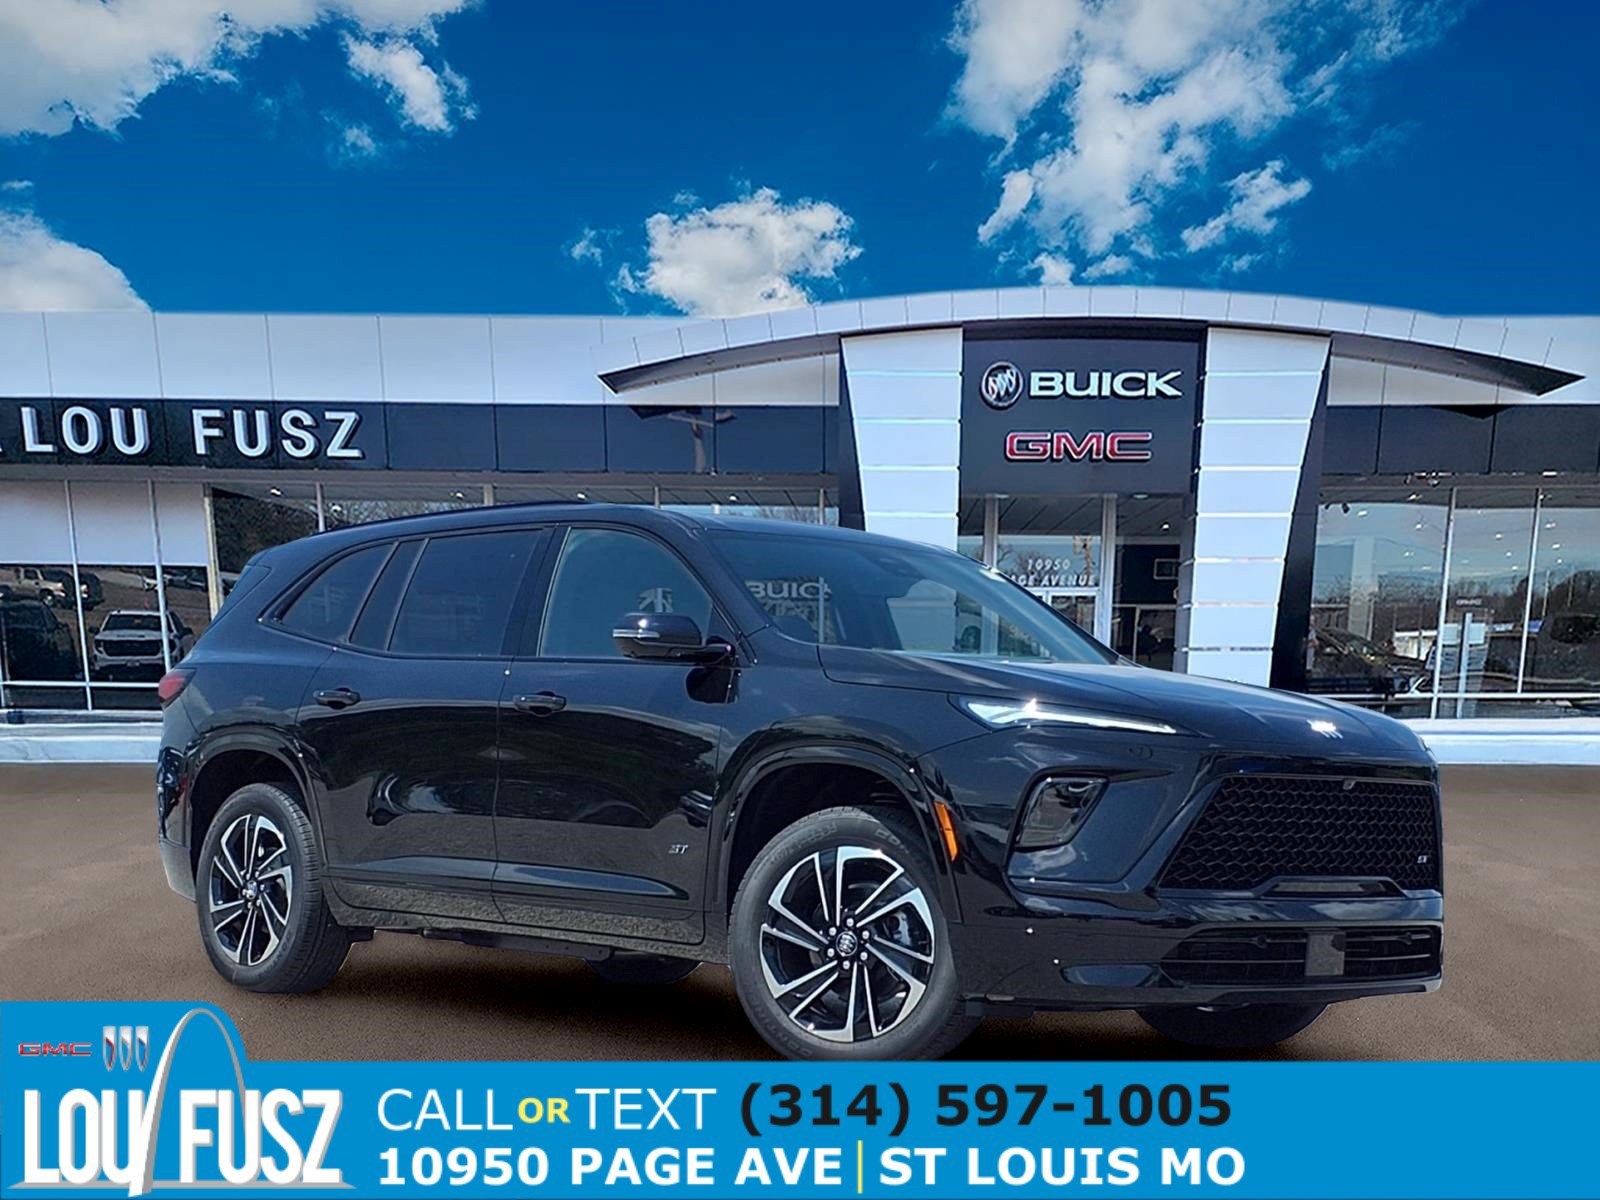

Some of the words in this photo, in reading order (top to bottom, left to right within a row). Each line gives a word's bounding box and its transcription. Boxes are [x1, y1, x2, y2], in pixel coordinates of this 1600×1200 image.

[1029, 370, 1183, 397] BUICK
[20, 405, 150, 456] LOU
[191, 408, 364, 458] FUSZ
[1006, 431, 1152, 461] GMC
[1027, 559, 1071, 570] 10950
[1011, 574, 1036, 586] AGE
[1040, 574, 1096, 586] AVENUE
